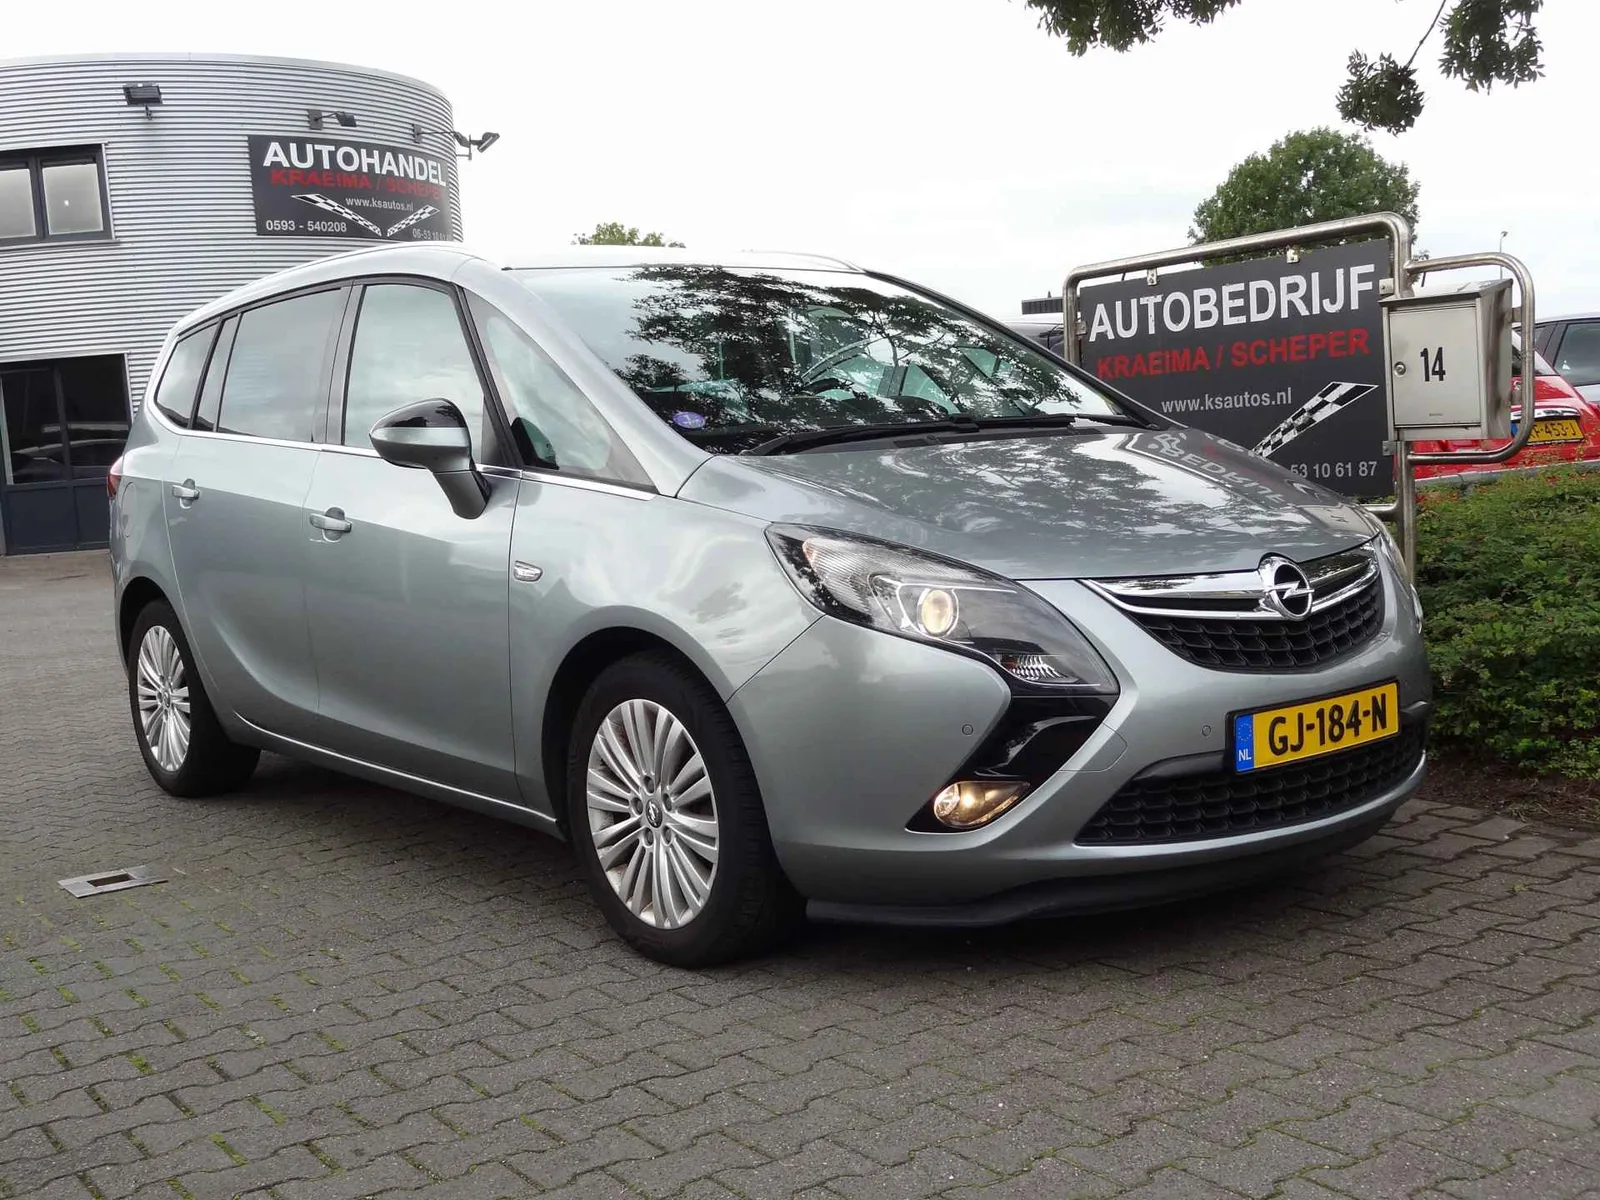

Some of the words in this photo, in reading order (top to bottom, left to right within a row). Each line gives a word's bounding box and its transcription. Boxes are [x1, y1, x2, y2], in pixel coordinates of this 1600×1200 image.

[262, 141, 447, 187] AUTOHANDEL
[269, 168, 371, 189] KRAEIMA
[386, 176, 444, 201] SCHEPE
[345, 196, 414, 213] www.ksautos.nl
[266, 219, 296, 231] 0593
[307, 220, 347, 233] 540208
[1088, 263, 1376, 342] AUTOBEDRIJF
[1096, 345, 1211, 381] KRAEIMA
[1215, 343, 1224, 369] /
[1230, 327, 1371, 368] SCHEPER
[1420, 346, 1446, 382] 14
[1161, 386, 1293, 414] www.ksautos.nl
[1313, 463, 1331, 478] 10
[1335, 462, 1352, 478] 61
[1358, 461, 1377, 477] 87
[1268, 692, 1388, 757] GJ-184-N
[1238, 748, 1252, 762] NL
